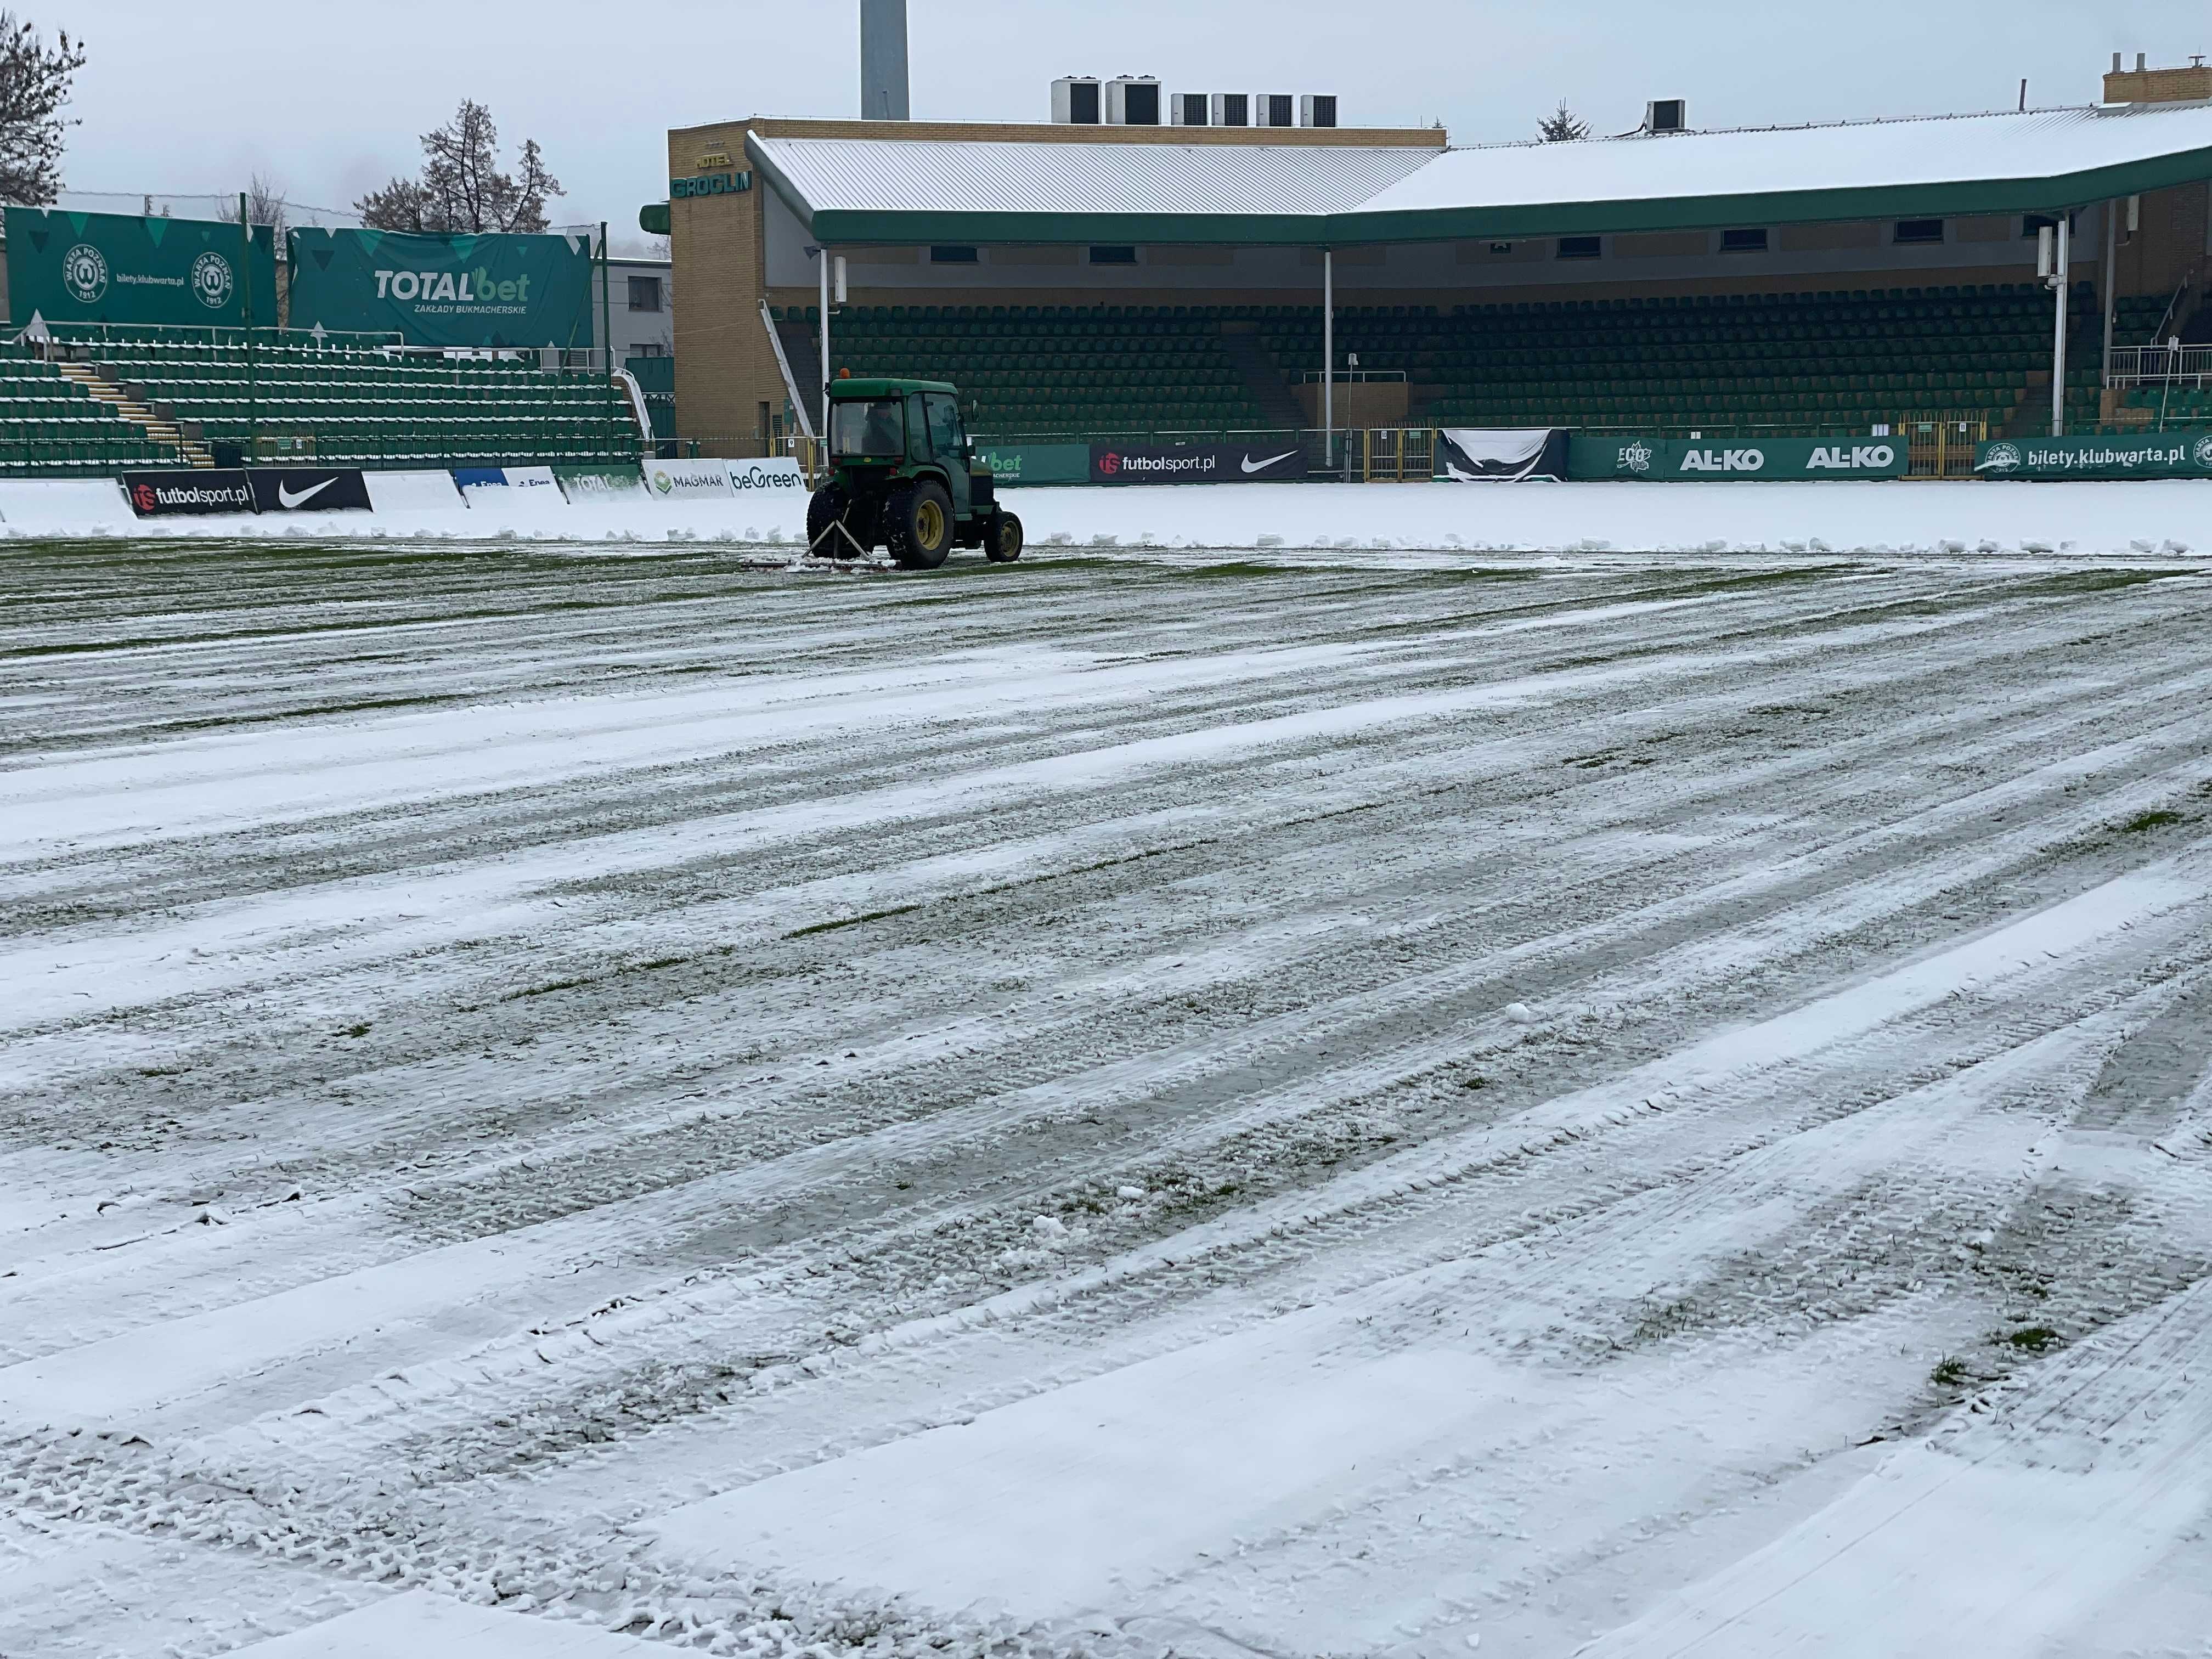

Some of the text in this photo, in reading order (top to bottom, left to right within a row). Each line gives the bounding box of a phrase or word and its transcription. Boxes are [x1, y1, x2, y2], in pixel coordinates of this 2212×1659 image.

[65, 249, 82, 281] WARTA
[194, 257, 209, 287] WARTA
[116, 273, 184, 287] bilety.klubwarta.pl
[79, 290, 96, 299] 1912
[414, 304, 527, 314] ZAKŁADY BUKMACHERSKIE
[1618, 447, 1645, 462] ECO
[1679, 449, 1764, 471] AL-KO
[1805, 445, 1894, 469] AL-KO
[1988, 445, 2018, 461] ARTA POZNA
[2028, 445, 2186, 469] bilety.klubwarta.pl
[1122, 455, 1215, 473] futbolsport.pl
[673, 474, 724, 488] MAGMAR
[730, 466, 802, 489] beGreen
[156, 485, 249, 506] futbolsport.pl
